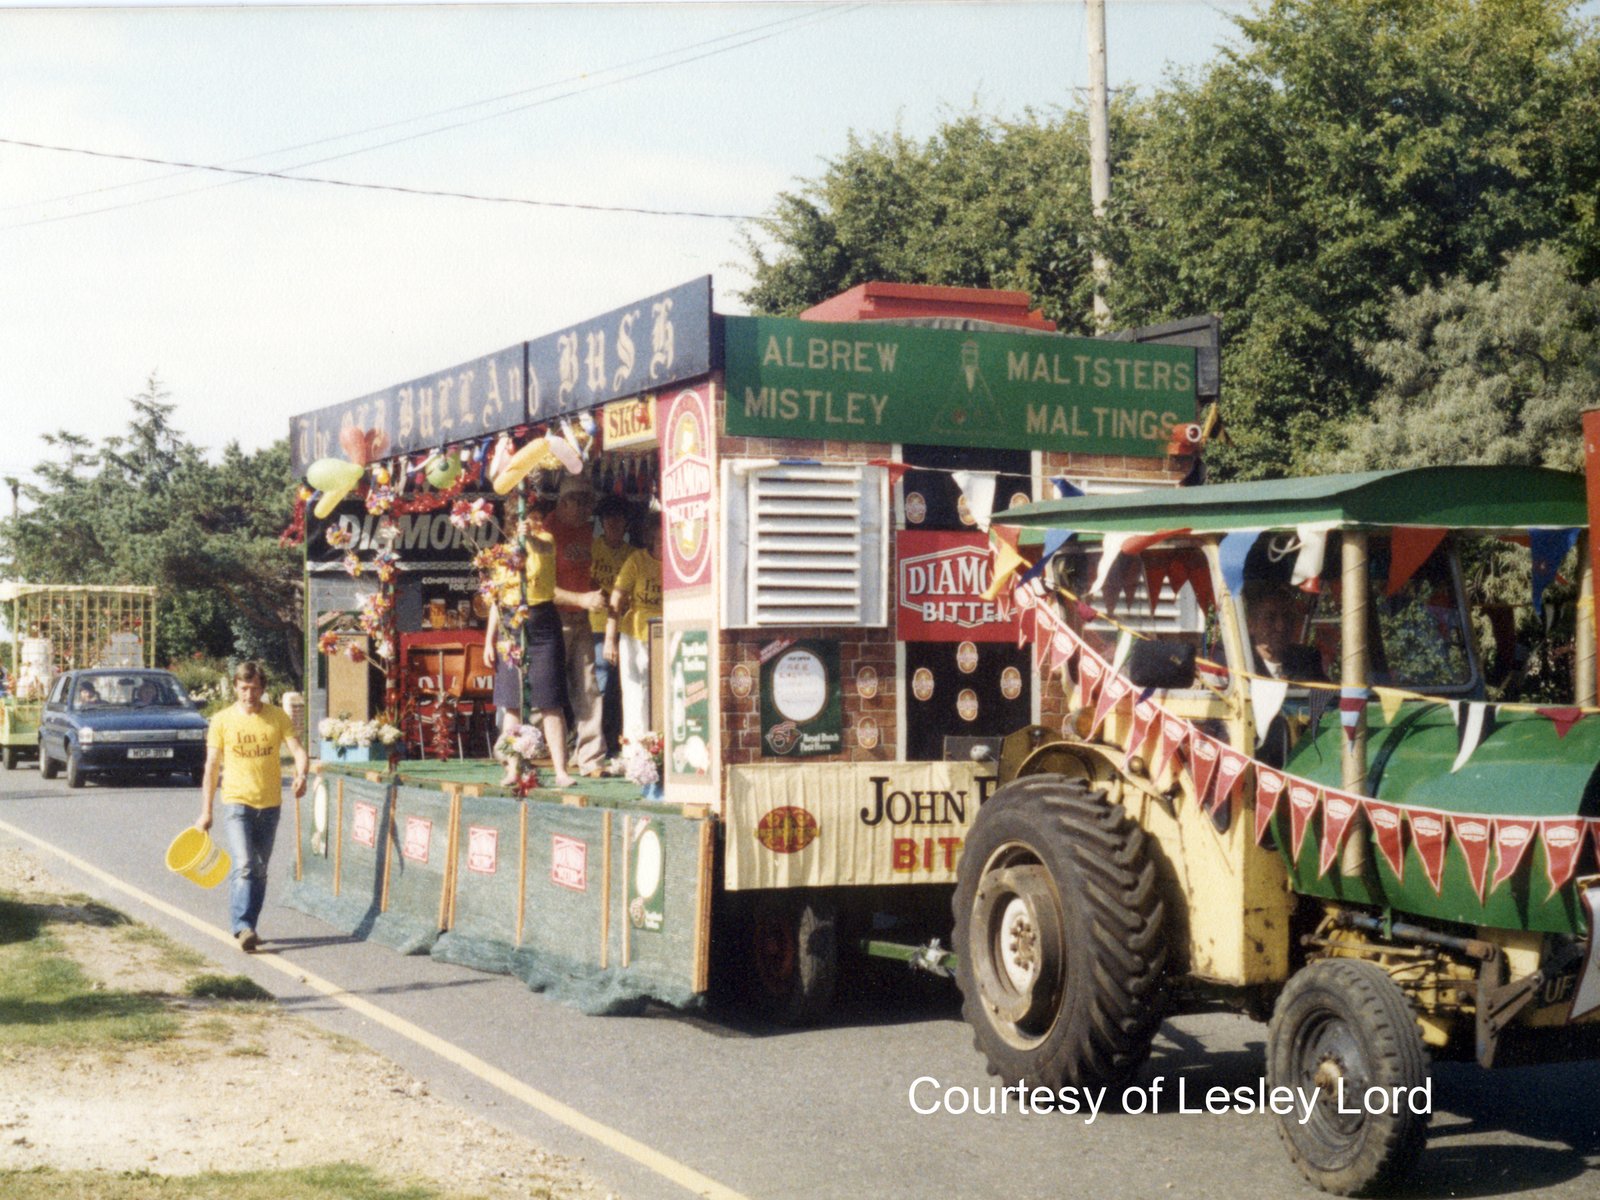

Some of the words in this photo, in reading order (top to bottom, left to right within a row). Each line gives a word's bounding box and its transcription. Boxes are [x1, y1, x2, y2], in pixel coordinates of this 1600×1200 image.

[557, 297, 676, 407] BUSH
[763, 334, 899, 375] ALBREW
[1007, 349, 1192, 392] MALTSTERS
[744, 385, 889, 426] MISTLEY
[1026, 403, 1179, 441] MALTINGS
[231, 743, 274, 758] Skolar
[860, 776, 969, 827] JOHN
[892, 836, 965, 874] BIT
